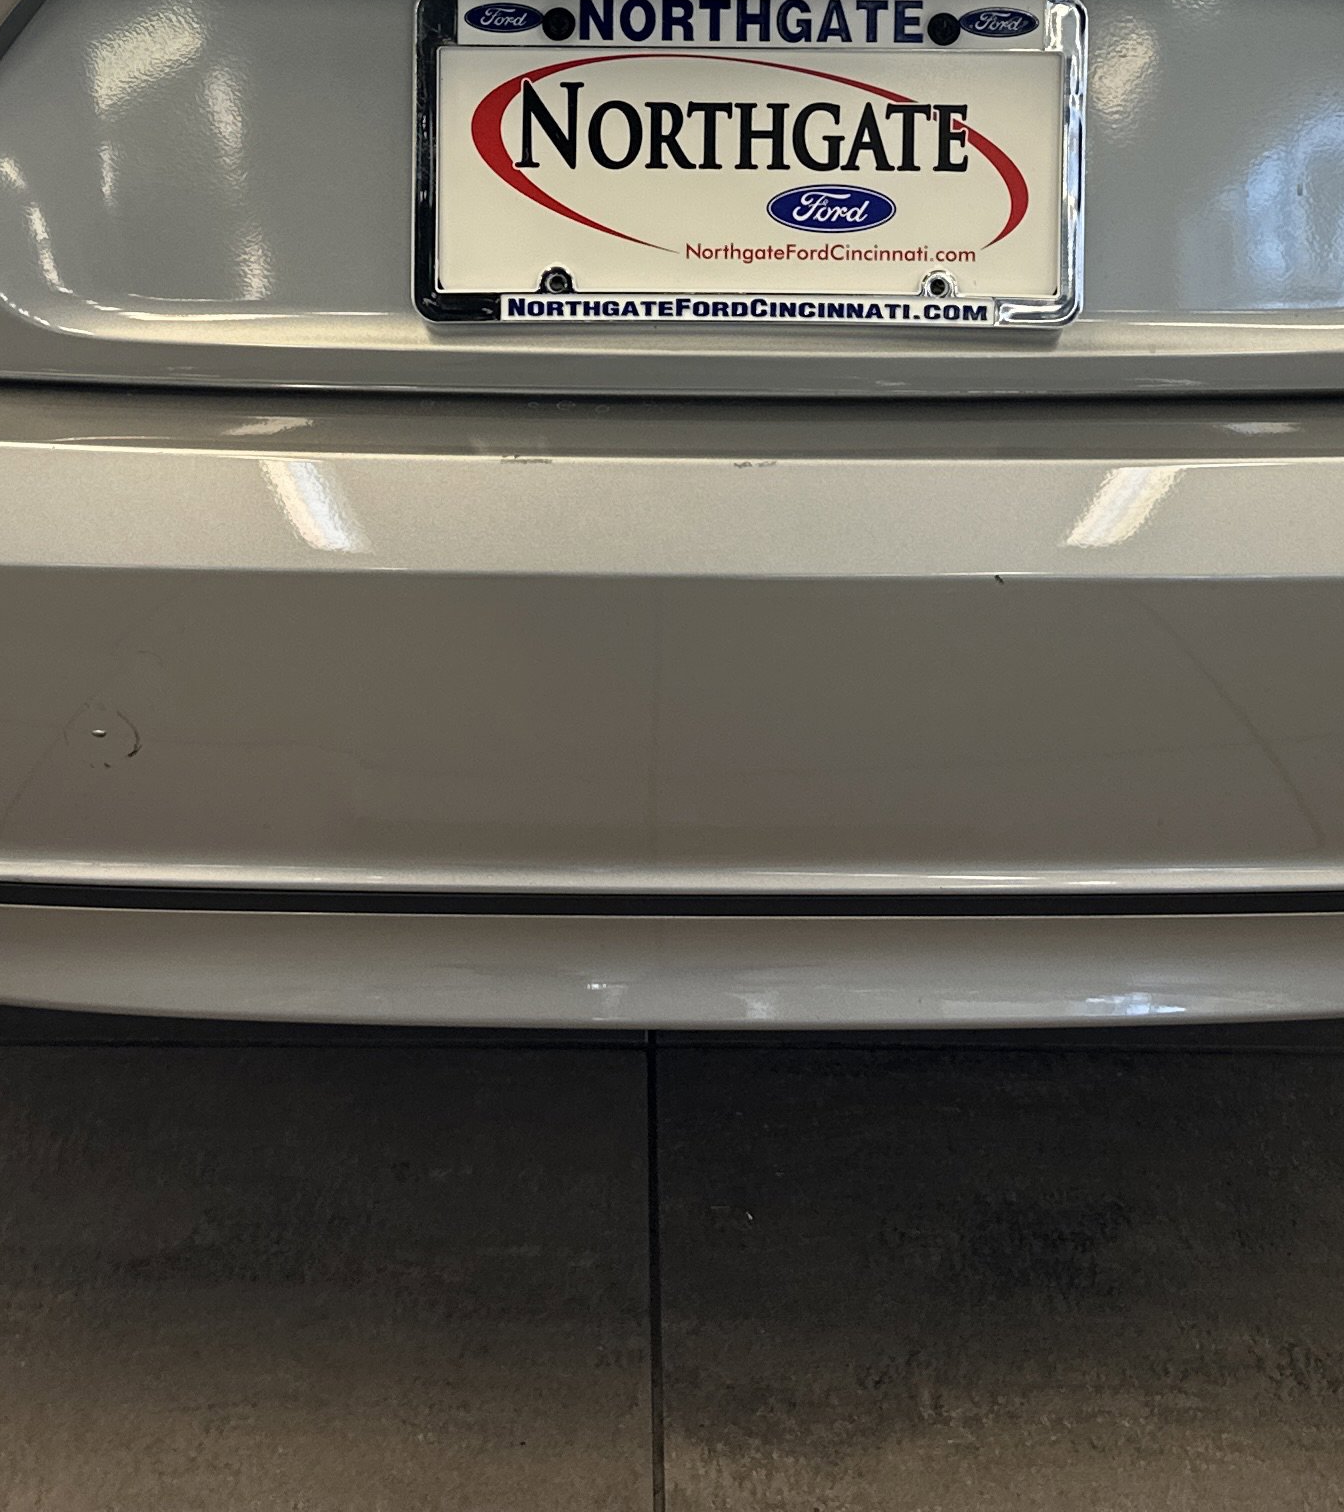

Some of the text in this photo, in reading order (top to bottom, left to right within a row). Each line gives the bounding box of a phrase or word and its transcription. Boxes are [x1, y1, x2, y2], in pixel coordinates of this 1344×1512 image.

[480, 6, 528, 27] Ford
[974, 11, 1023, 32] Ford
[792, 191, 870, 225] Ford
[685, 242, 977, 264] NorthgateFordCincinnati.com
